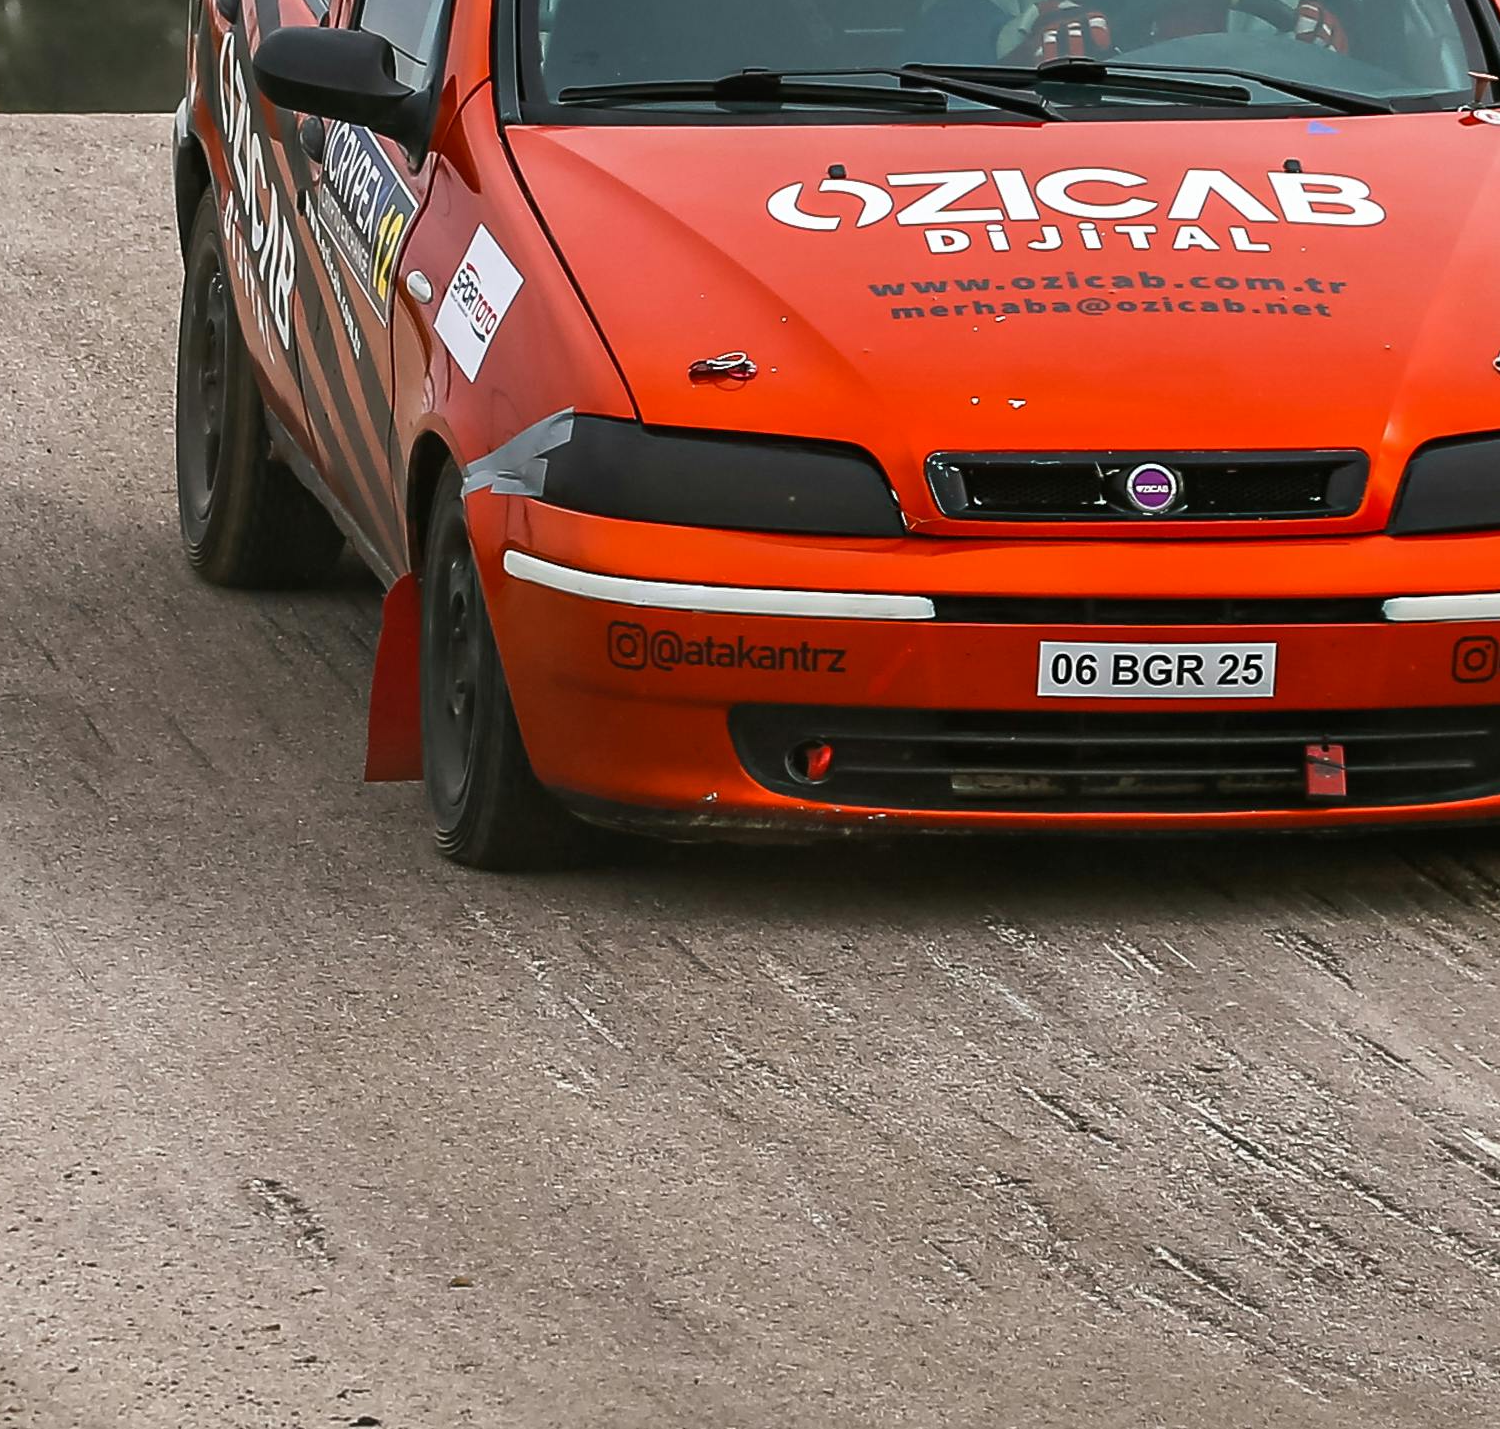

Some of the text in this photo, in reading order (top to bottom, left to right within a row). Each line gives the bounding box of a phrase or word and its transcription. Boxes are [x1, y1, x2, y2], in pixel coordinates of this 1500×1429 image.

[766, 166, 1386, 232] OZICAB
[373, 203, 404, 302] 12
[867, 271, 1348, 298] www.ozicab.com.tr
[890, 296, 1333, 320] merhaba@ozicab.net
[651, 629, 847, 673] @atakantrz
[1051, 652, 1264, 687] 06 BGR 25
